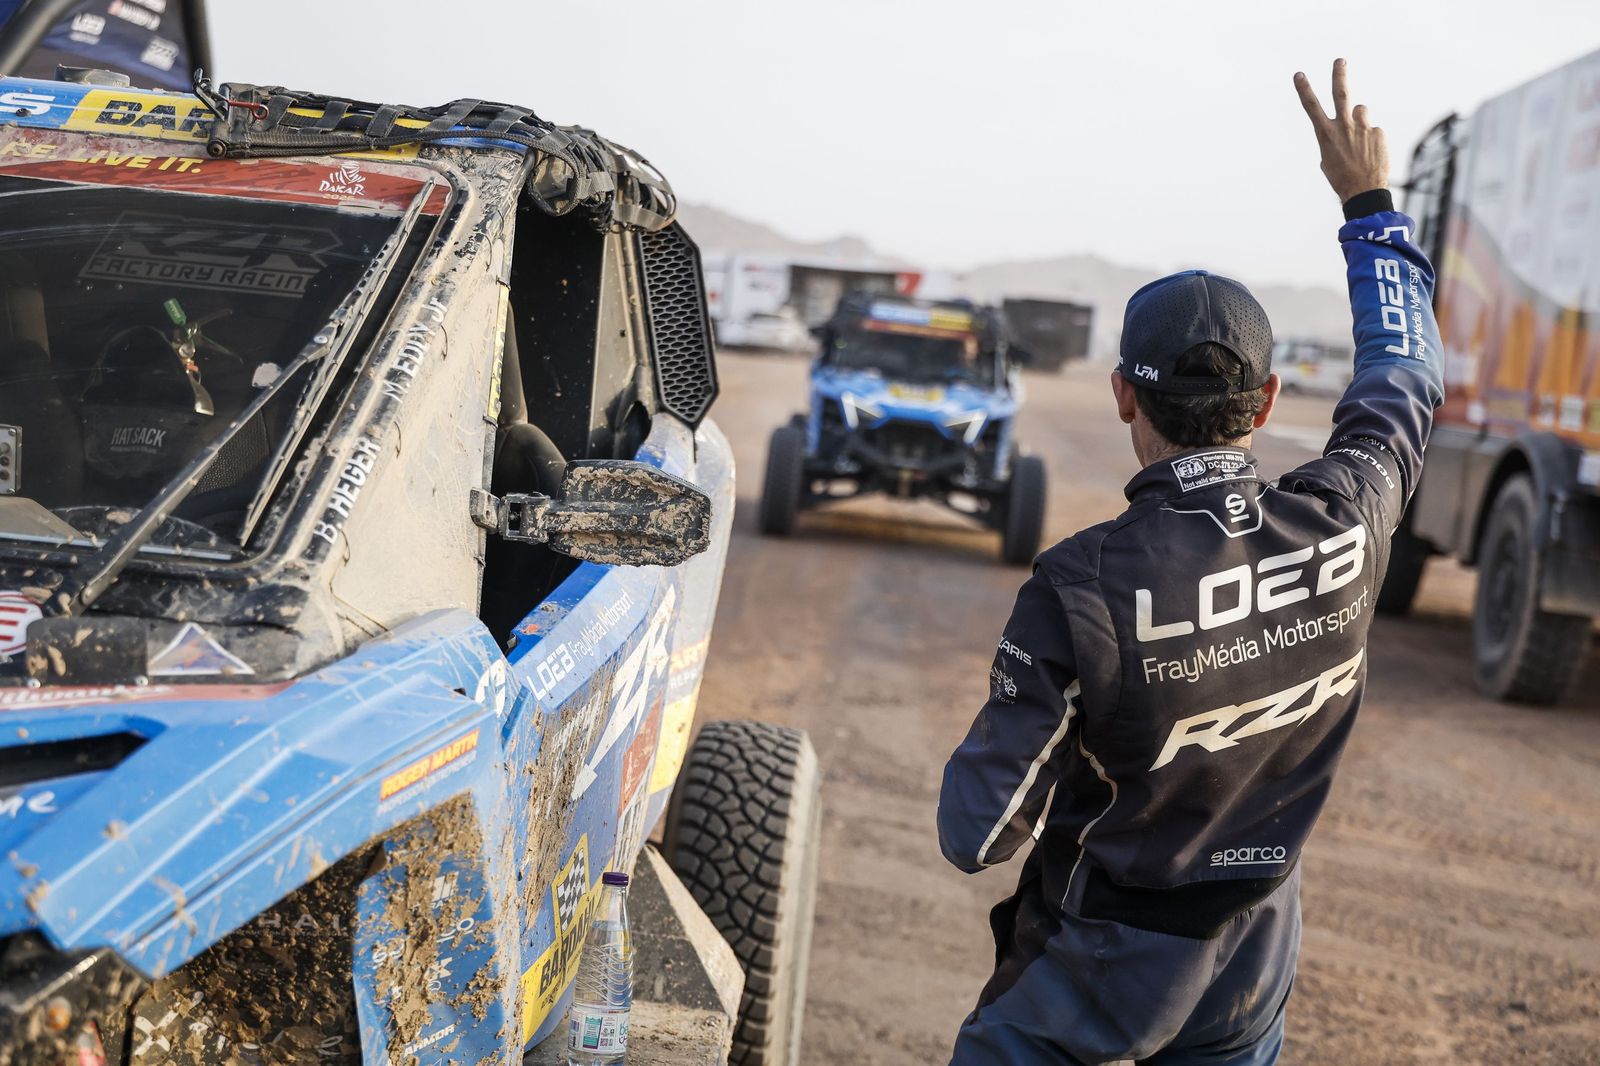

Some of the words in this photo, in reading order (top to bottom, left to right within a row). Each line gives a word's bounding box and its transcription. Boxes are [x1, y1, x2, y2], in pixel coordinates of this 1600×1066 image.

[67, 147, 154, 169] LIVE
[158, 156, 205, 174] IT.
[319, 180, 366, 196] DAKAR
[88, 256, 213, 282] FACTORY
[219, 269, 314, 291] RACIN
[1374, 258, 1410, 357] LOEB
[393, 323, 436, 379] EDDY
[1134, 363, 1159, 382] LFM
[111, 427, 167, 448] HATSACK
[327, 436, 382, 519] HEGER
[313, 519, 343, 545] B.
[1135, 524, 1367, 643] LOEB
[1142, 636, 1261, 684] FrayMédia
[1262, 585, 1369, 653] Motorsport
[526, 643, 576, 701] LOEB
[1149, 647, 1364, 772] RZR
[429, 727, 480, 775] MARTIN
[1210, 845, 1286, 867] sparco
